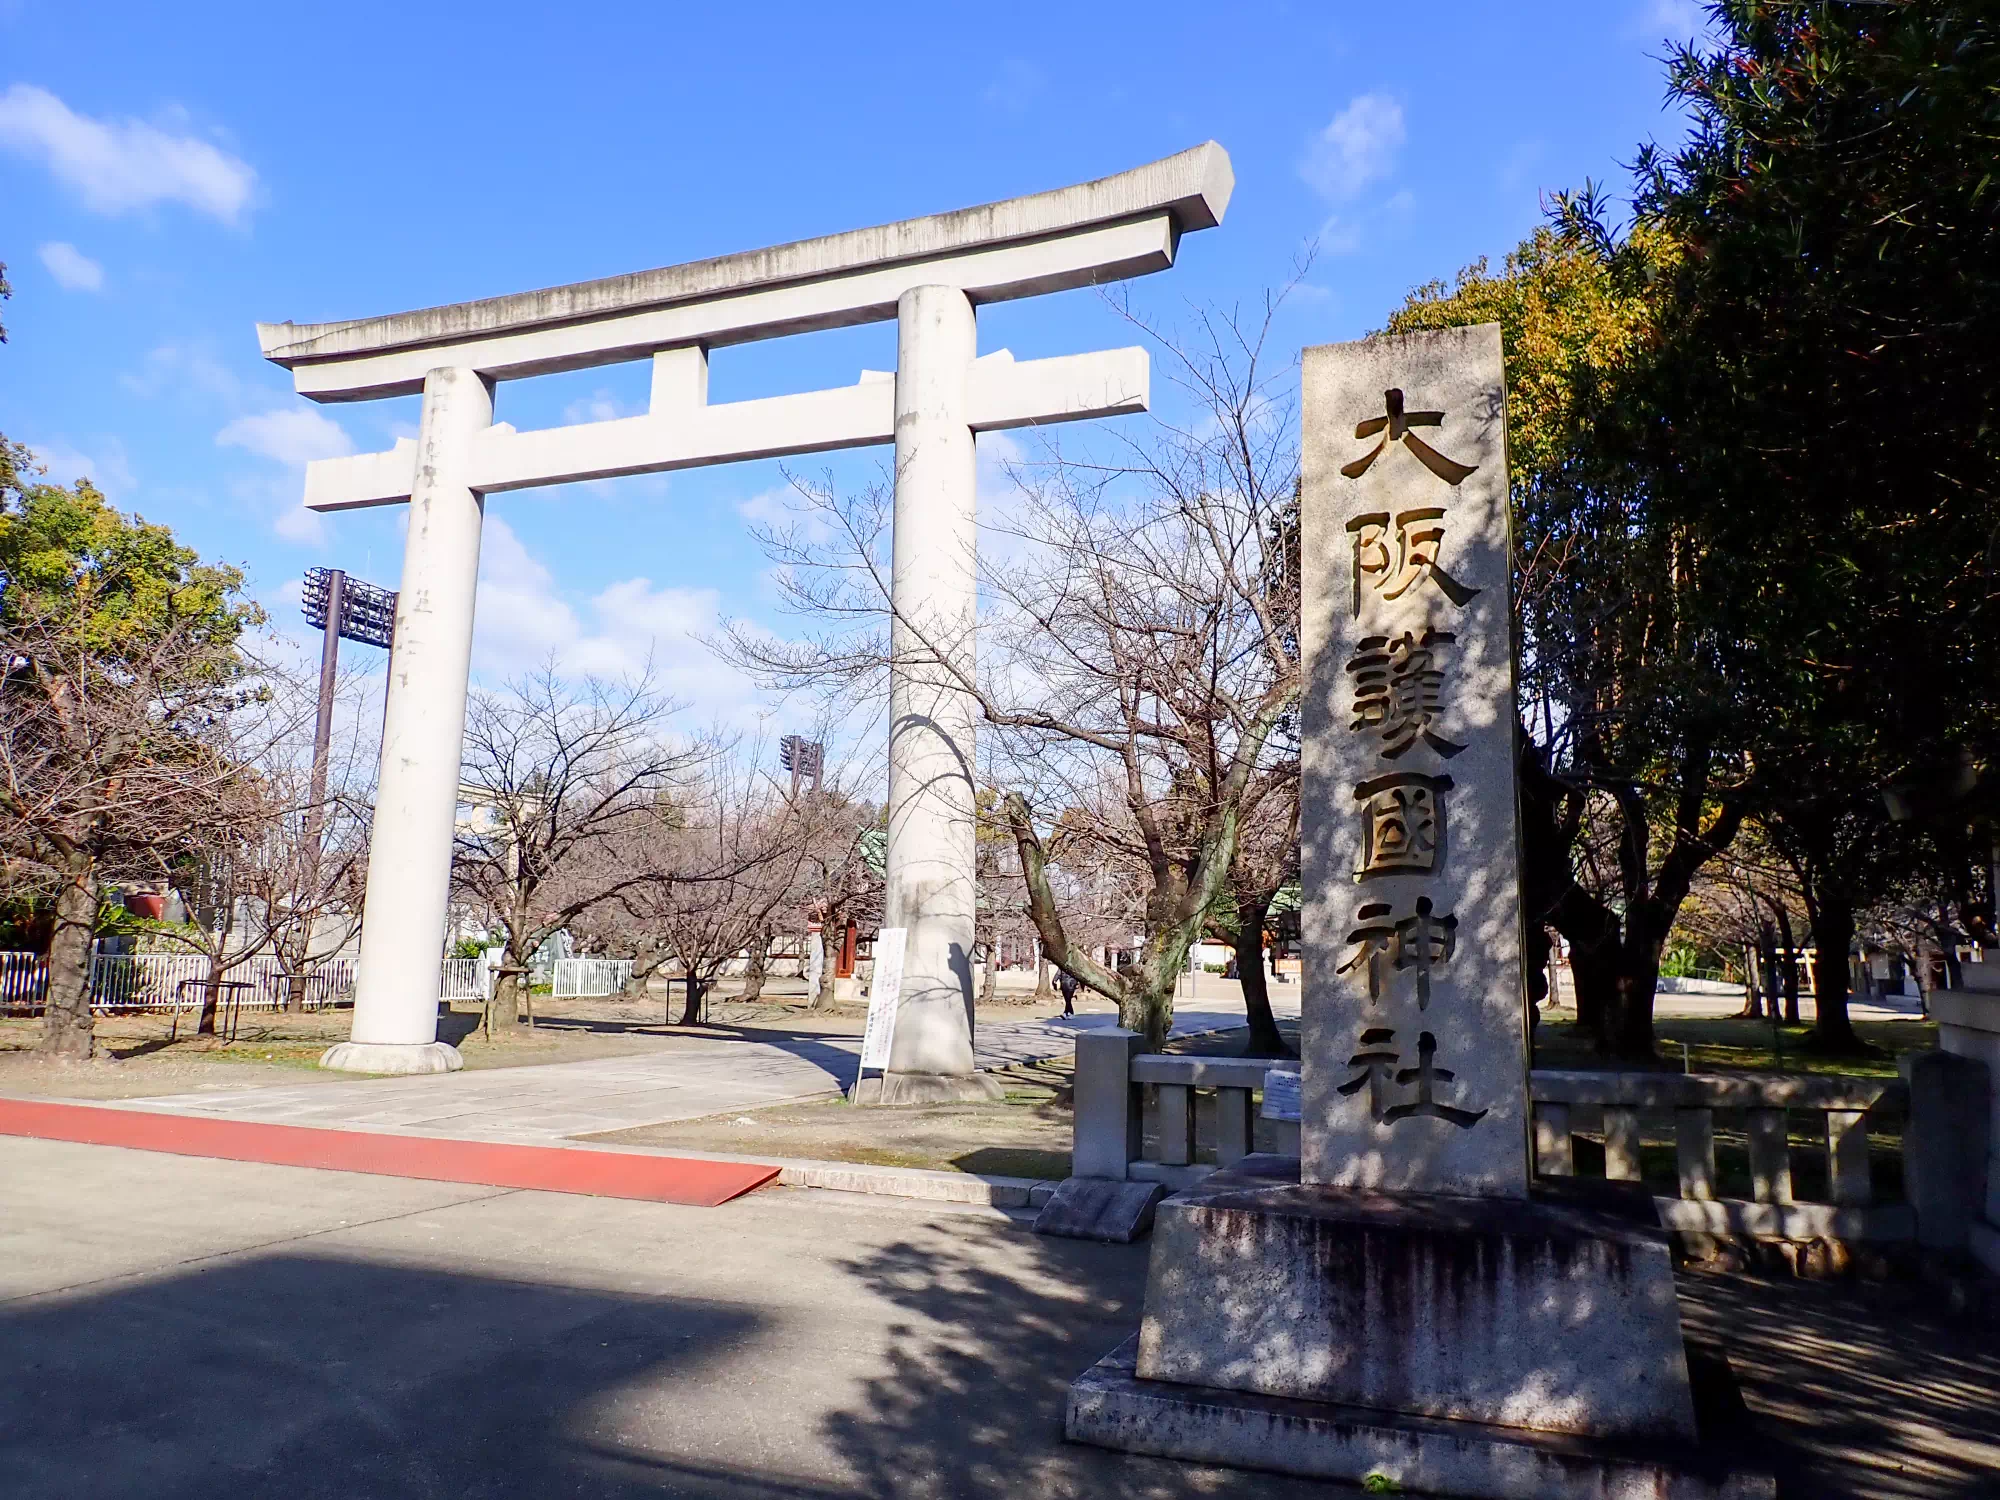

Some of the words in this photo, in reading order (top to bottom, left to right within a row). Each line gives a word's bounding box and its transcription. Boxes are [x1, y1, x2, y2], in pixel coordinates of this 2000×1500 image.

[1336, 388, 1489, 1130] 大阪護國神社
